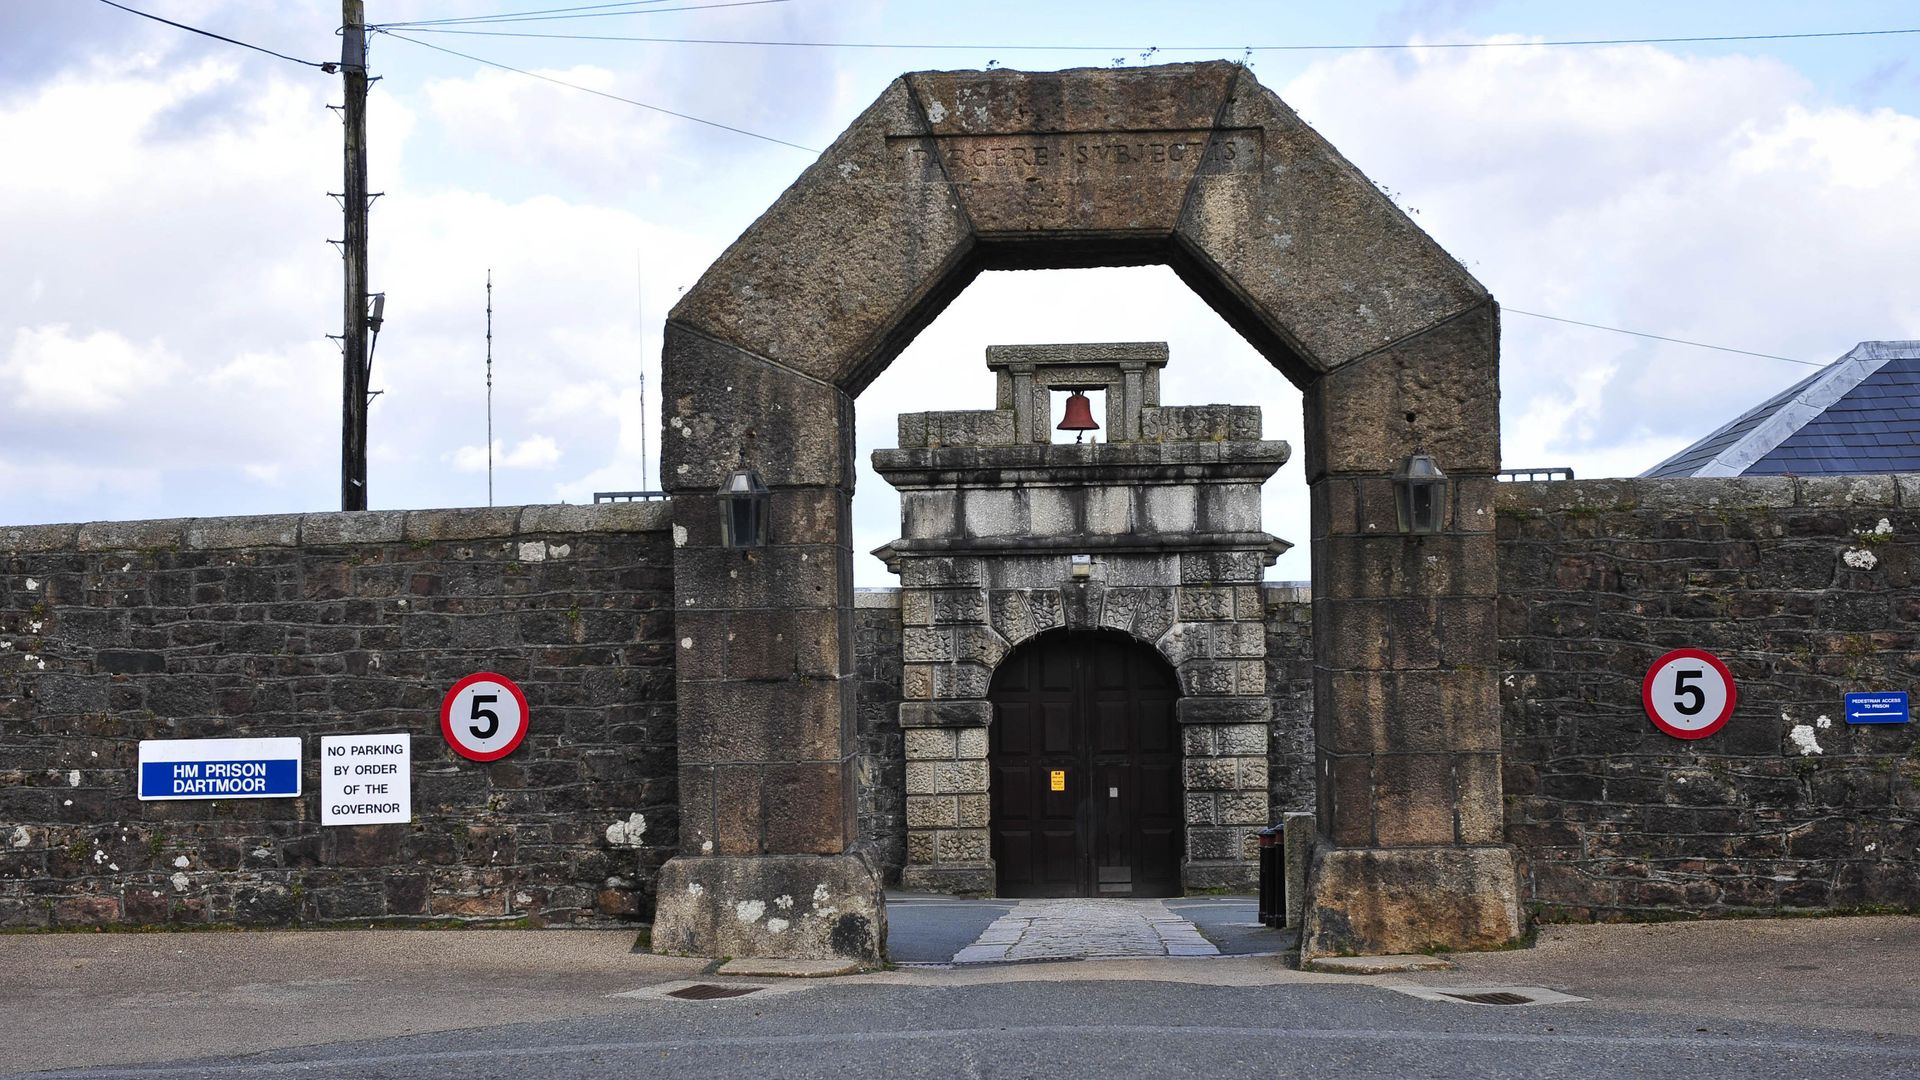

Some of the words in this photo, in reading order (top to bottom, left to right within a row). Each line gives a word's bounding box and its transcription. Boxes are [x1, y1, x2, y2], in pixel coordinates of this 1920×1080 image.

[1673, 670, 1706, 716] 5
[468, 694, 500, 740] 5
[327, 746, 346, 757] NO
[351, 744, 403, 756] PARKING
[173, 765, 198, 778] HM
[205, 763, 267, 778] PRISON
[334, 765, 350, 776] BY
[355, 764, 397, 775] ORDER
[173, 778, 266, 793] DARTMOOR
[343, 784, 360, 795] OF
[365, 783, 389, 795] THE
[331, 803, 400, 815] GOVERNOR
